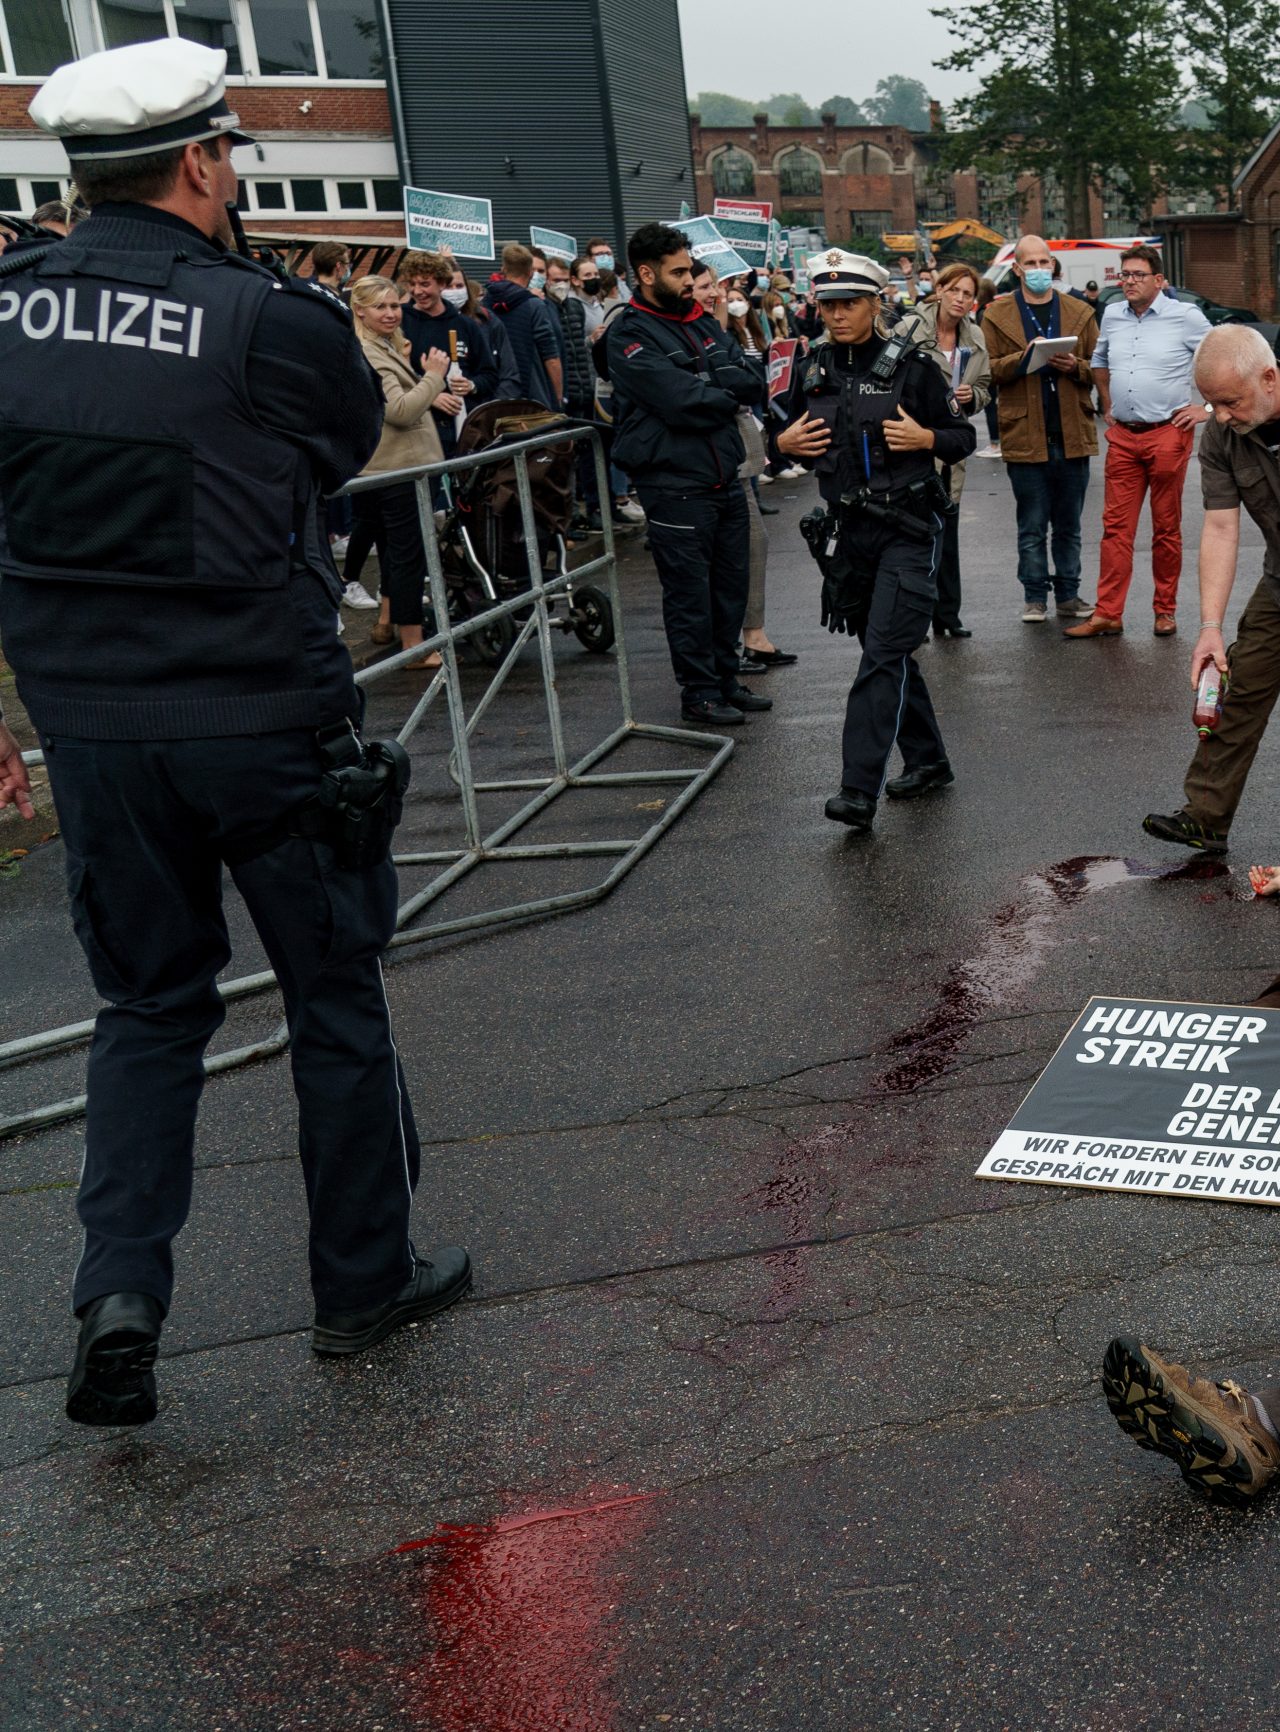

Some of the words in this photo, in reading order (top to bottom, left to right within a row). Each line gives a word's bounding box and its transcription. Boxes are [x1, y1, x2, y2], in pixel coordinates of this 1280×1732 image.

[413, 216, 441, 227] WEGEN
[443, 221, 485, 233] MORGEN.
[0, 288, 204, 358] POLIZEI
[1082, 1006, 1267, 1043] HUNGER
[1075, 1037, 1241, 1073] STREIK
[1181, 1082, 1262, 1113] DER
[1022, 1137, 1069, 1154] WIR
[1072, 1141, 1188, 1164] FORDERN
[1190, 1151, 1235, 1168] EIN
[990, 1158, 1118, 1183] GESPRÄCH
[1122, 1169, 1170, 1187] MIT
[1172, 1174, 1226, 1192] DEN
